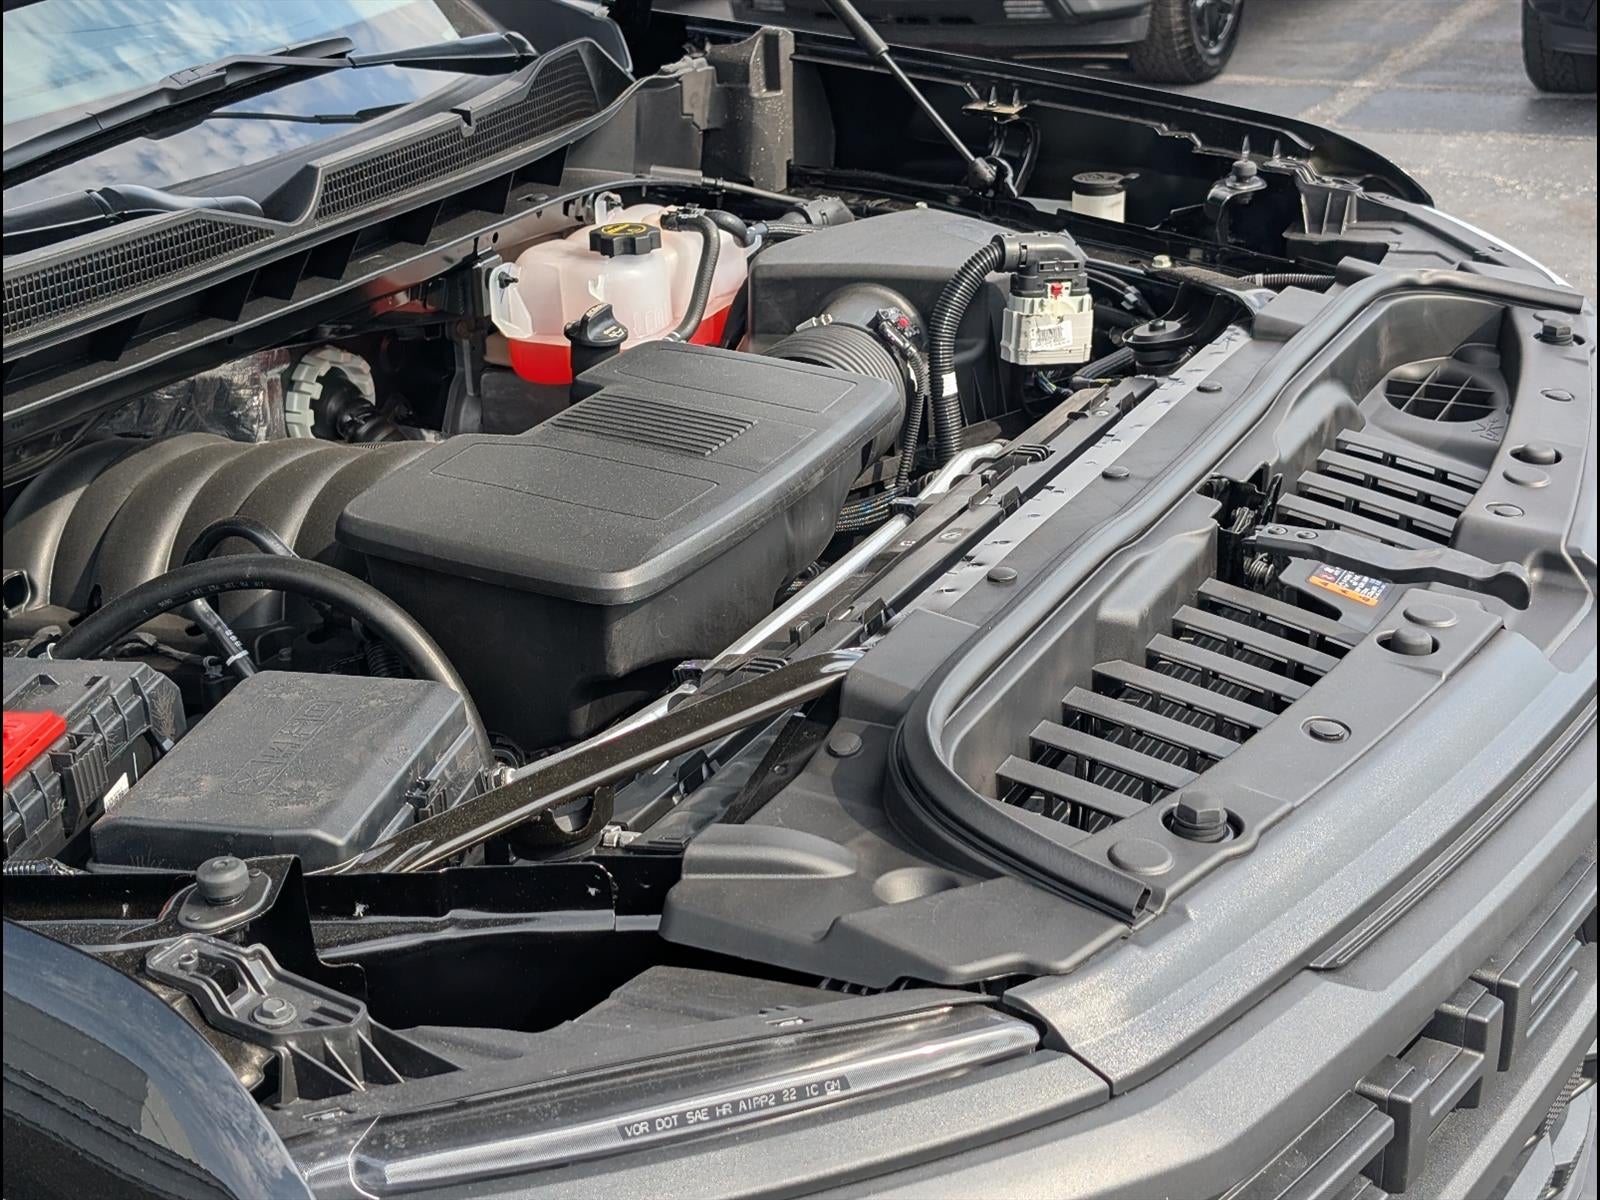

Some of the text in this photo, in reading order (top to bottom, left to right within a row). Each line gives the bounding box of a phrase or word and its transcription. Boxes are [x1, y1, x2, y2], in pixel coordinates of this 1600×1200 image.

[624, 1121, 650, 1137] VOR
[655, 1115, 679, 1131] DOT
[685, 1108, 711, 1124] SAE
[782, 1087, 797, 1102] 22
